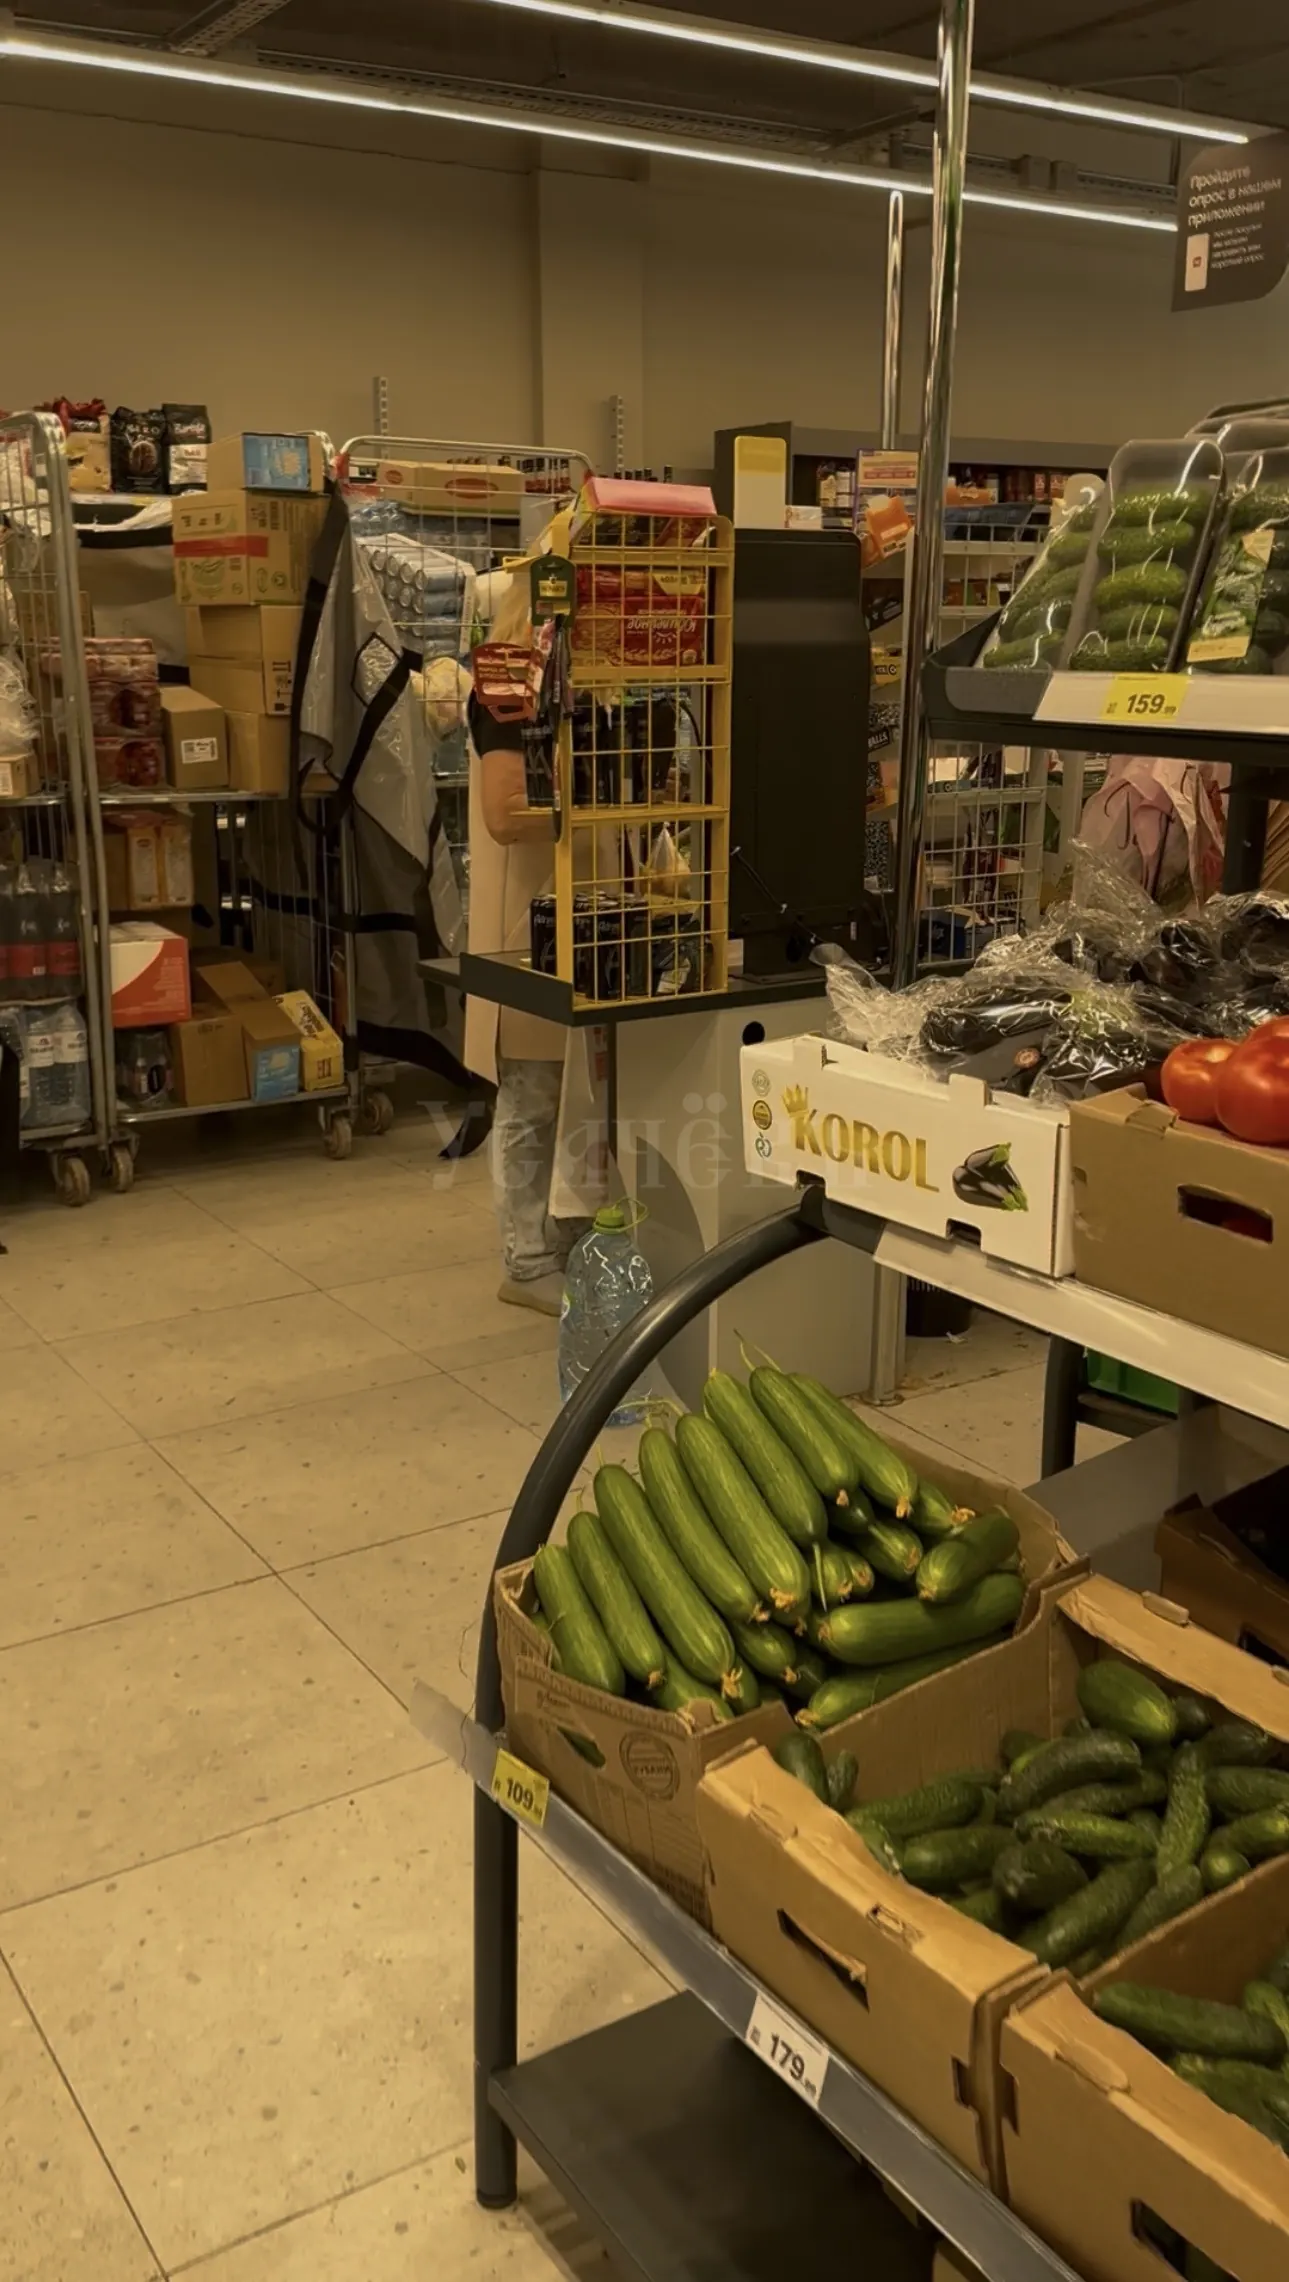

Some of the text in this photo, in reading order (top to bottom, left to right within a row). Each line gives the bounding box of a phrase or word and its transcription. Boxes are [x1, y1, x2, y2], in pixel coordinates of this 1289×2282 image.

[1189, 178, 1282, 209] опрос в нашем
[1190, 166, 1250, 190] Пройдите
[789, 1107, 940, 1193] KOROL
